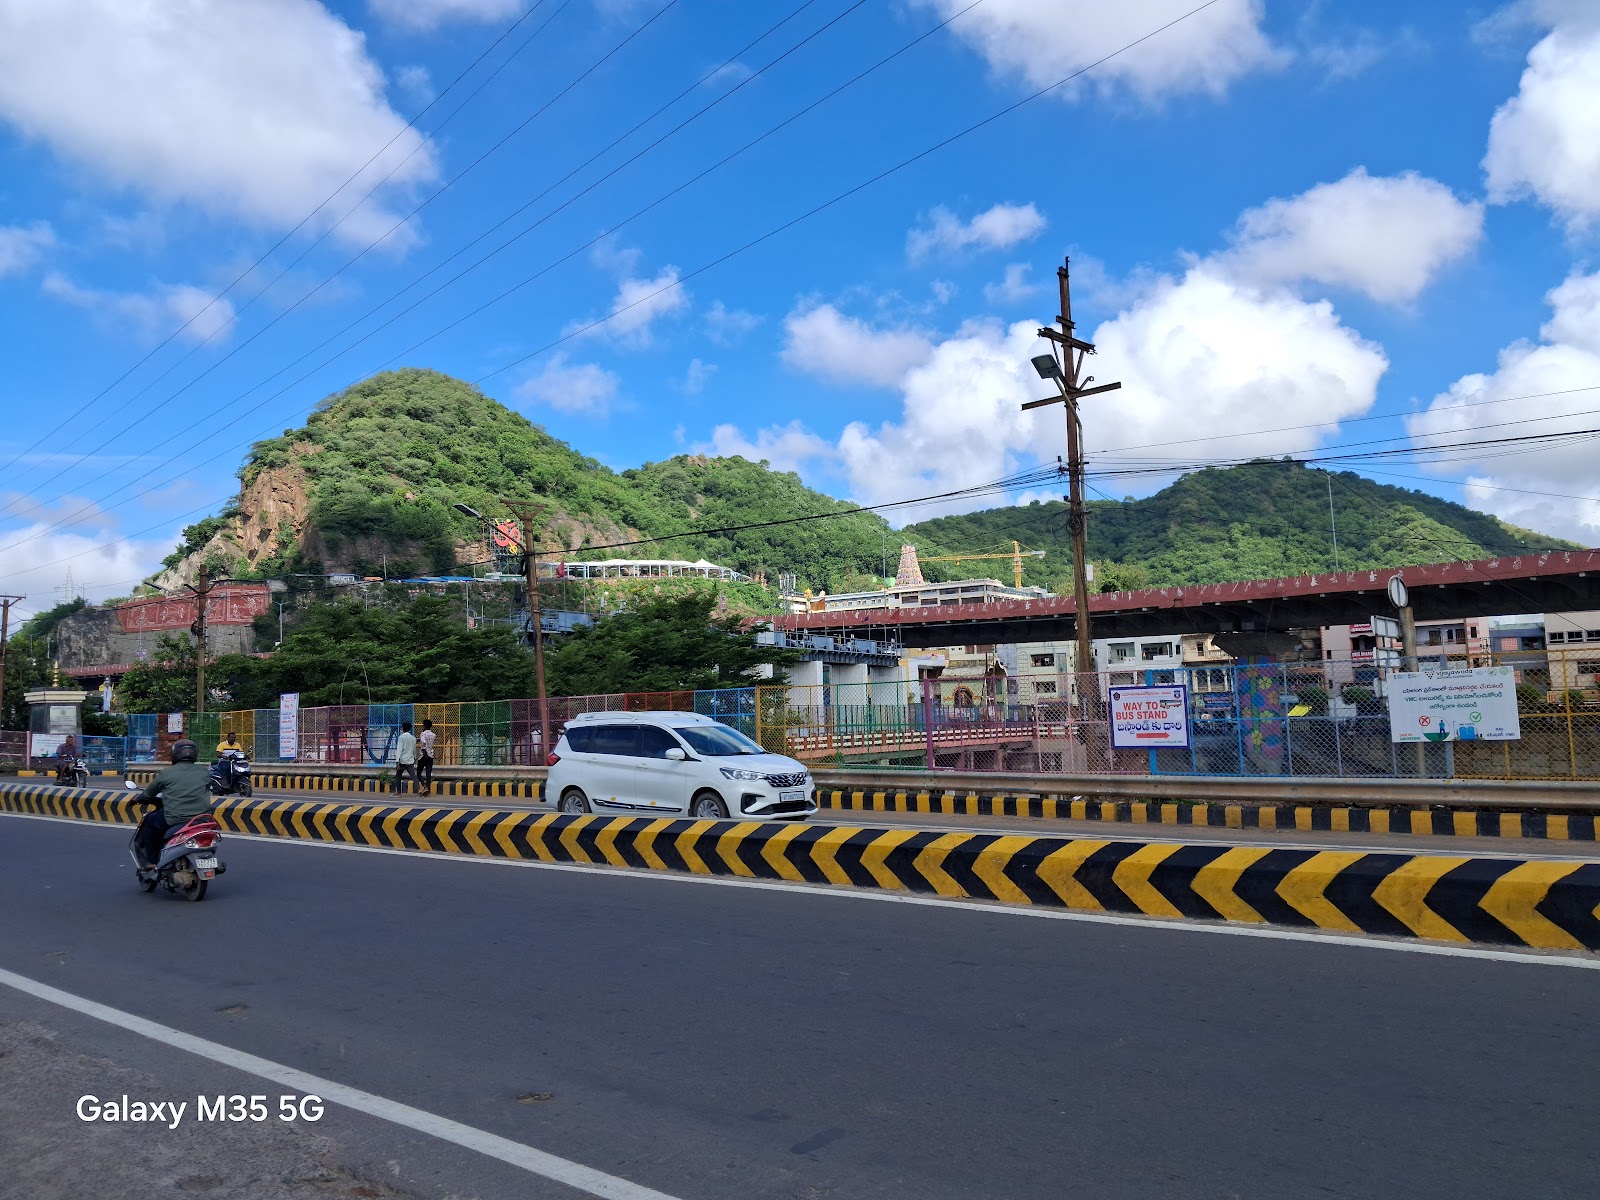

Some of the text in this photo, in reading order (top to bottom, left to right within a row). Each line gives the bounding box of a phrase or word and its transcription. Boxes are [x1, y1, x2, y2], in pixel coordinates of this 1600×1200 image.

[1123, 702, 1158, 711] WAY TO
[1116, 711, 1168, 720] BUS STAND
[1151, 721, 1161, 731] కు
[1163, 721, 1182, 731] దారి
